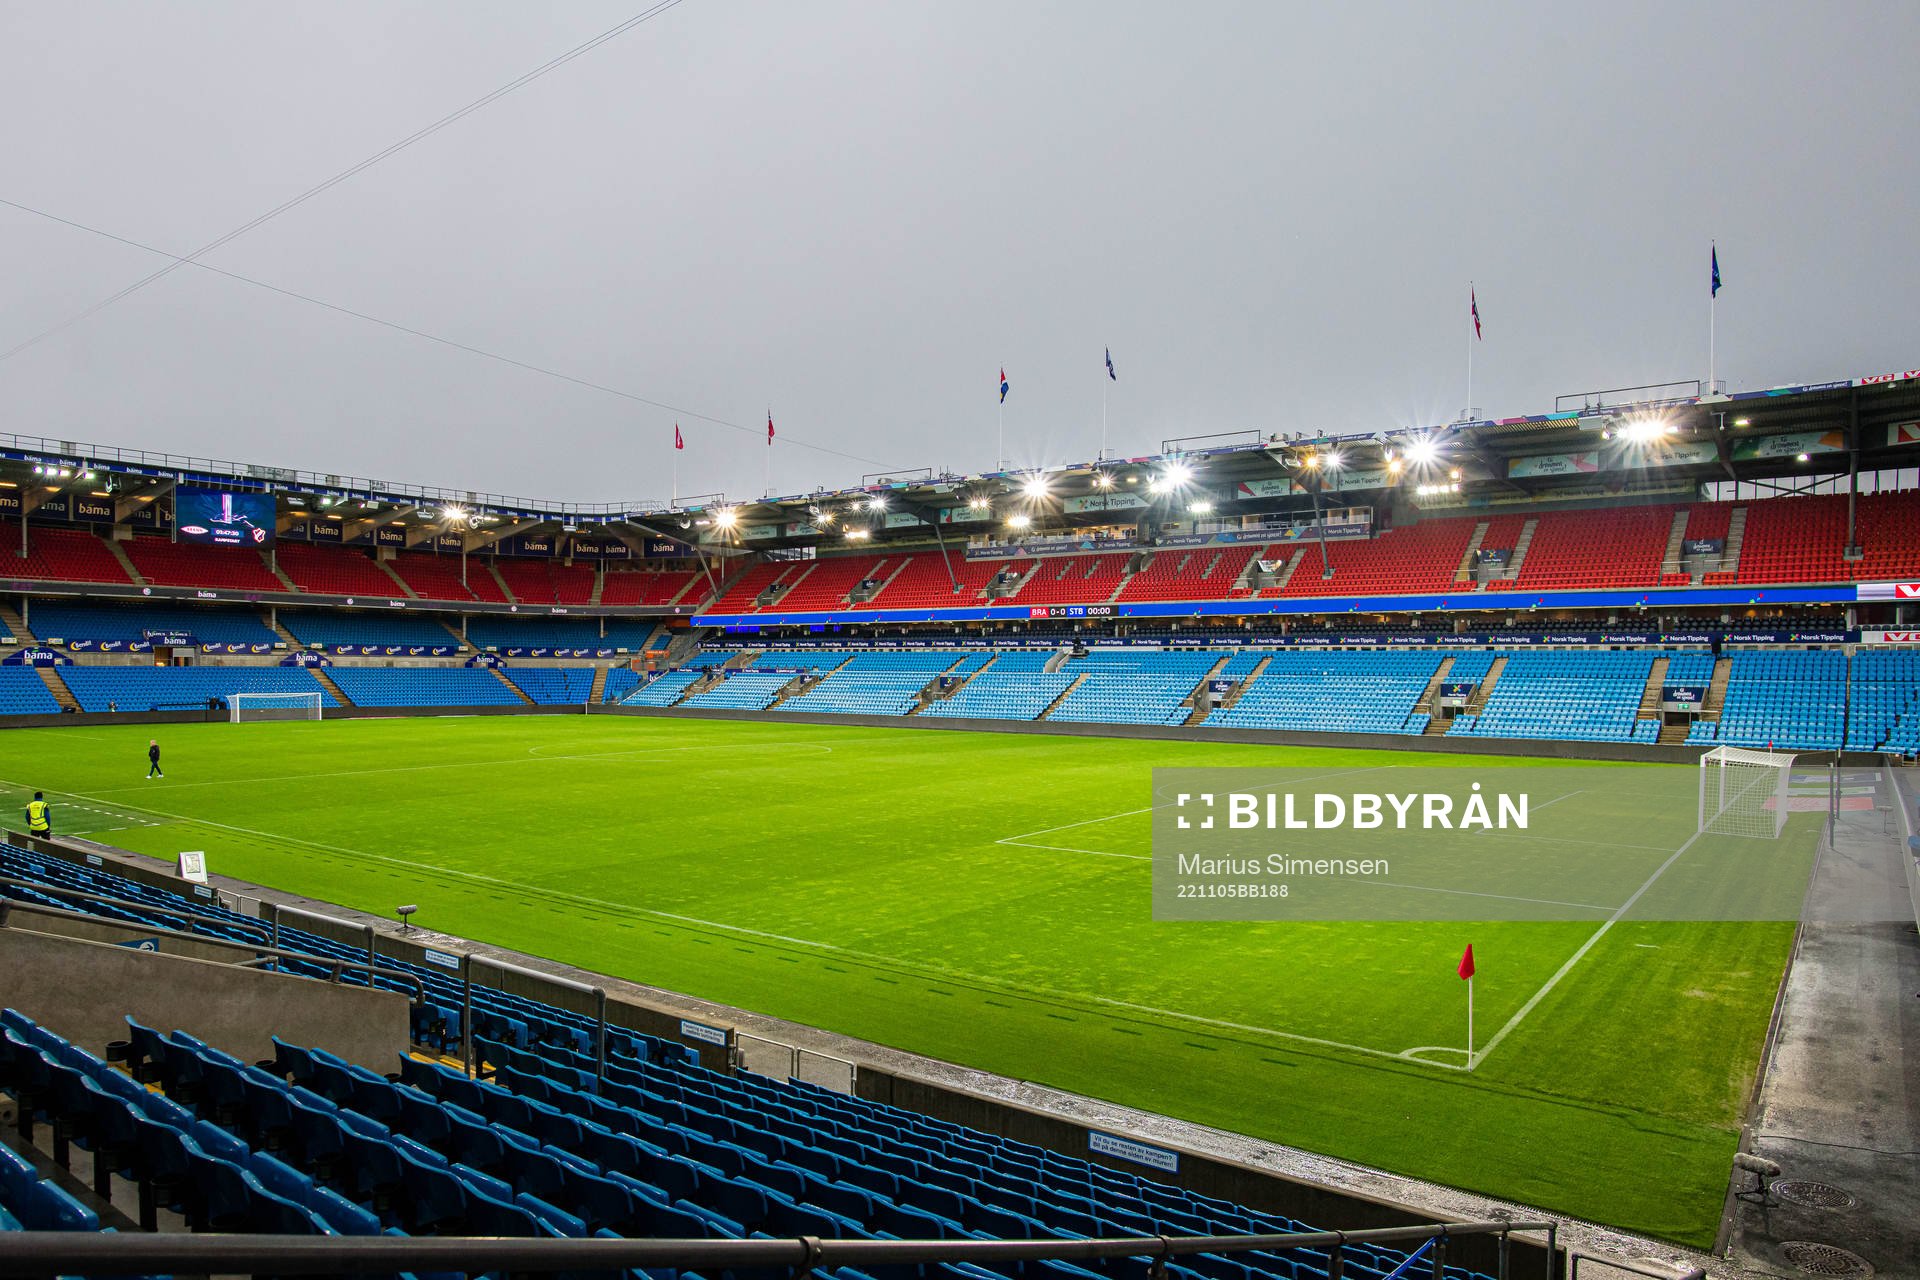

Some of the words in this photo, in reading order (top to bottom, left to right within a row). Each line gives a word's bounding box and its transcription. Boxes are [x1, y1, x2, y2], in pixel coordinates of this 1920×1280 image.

[1861, 373, 1895, 385] VG
[1110, 498, 1136, 507] Tipping
[78, 503, 111, 516] bama
[314, 524, 339, 536] bama
[380, 530, 403, 542] bama
[440, 536, 462, 547] bama
[524, 541, 548, 551] bama
[653, 542, 674, 552] bama
[197, 590, 217, 599] bama
[1031, 608, 1047, 616] BRA
[1069, 607, 1084, 615] STB
[1087, 606, 1111, 615] 00:00
[164, 636, 187, 645] bama
[23, 650, 53, 660] bama
[296, 653, 318, 662] bama
[1101, 1143, 1109, 1152] på
[1109, 1145, 1127, 1156] denne
[1127, 1150, 1144, 1160] siden
[1102, 1137, 1110, 1145] du
[1118, 1142, 1137, 1152] resten
[1145, 1147, 1173, 1161] kampen?
